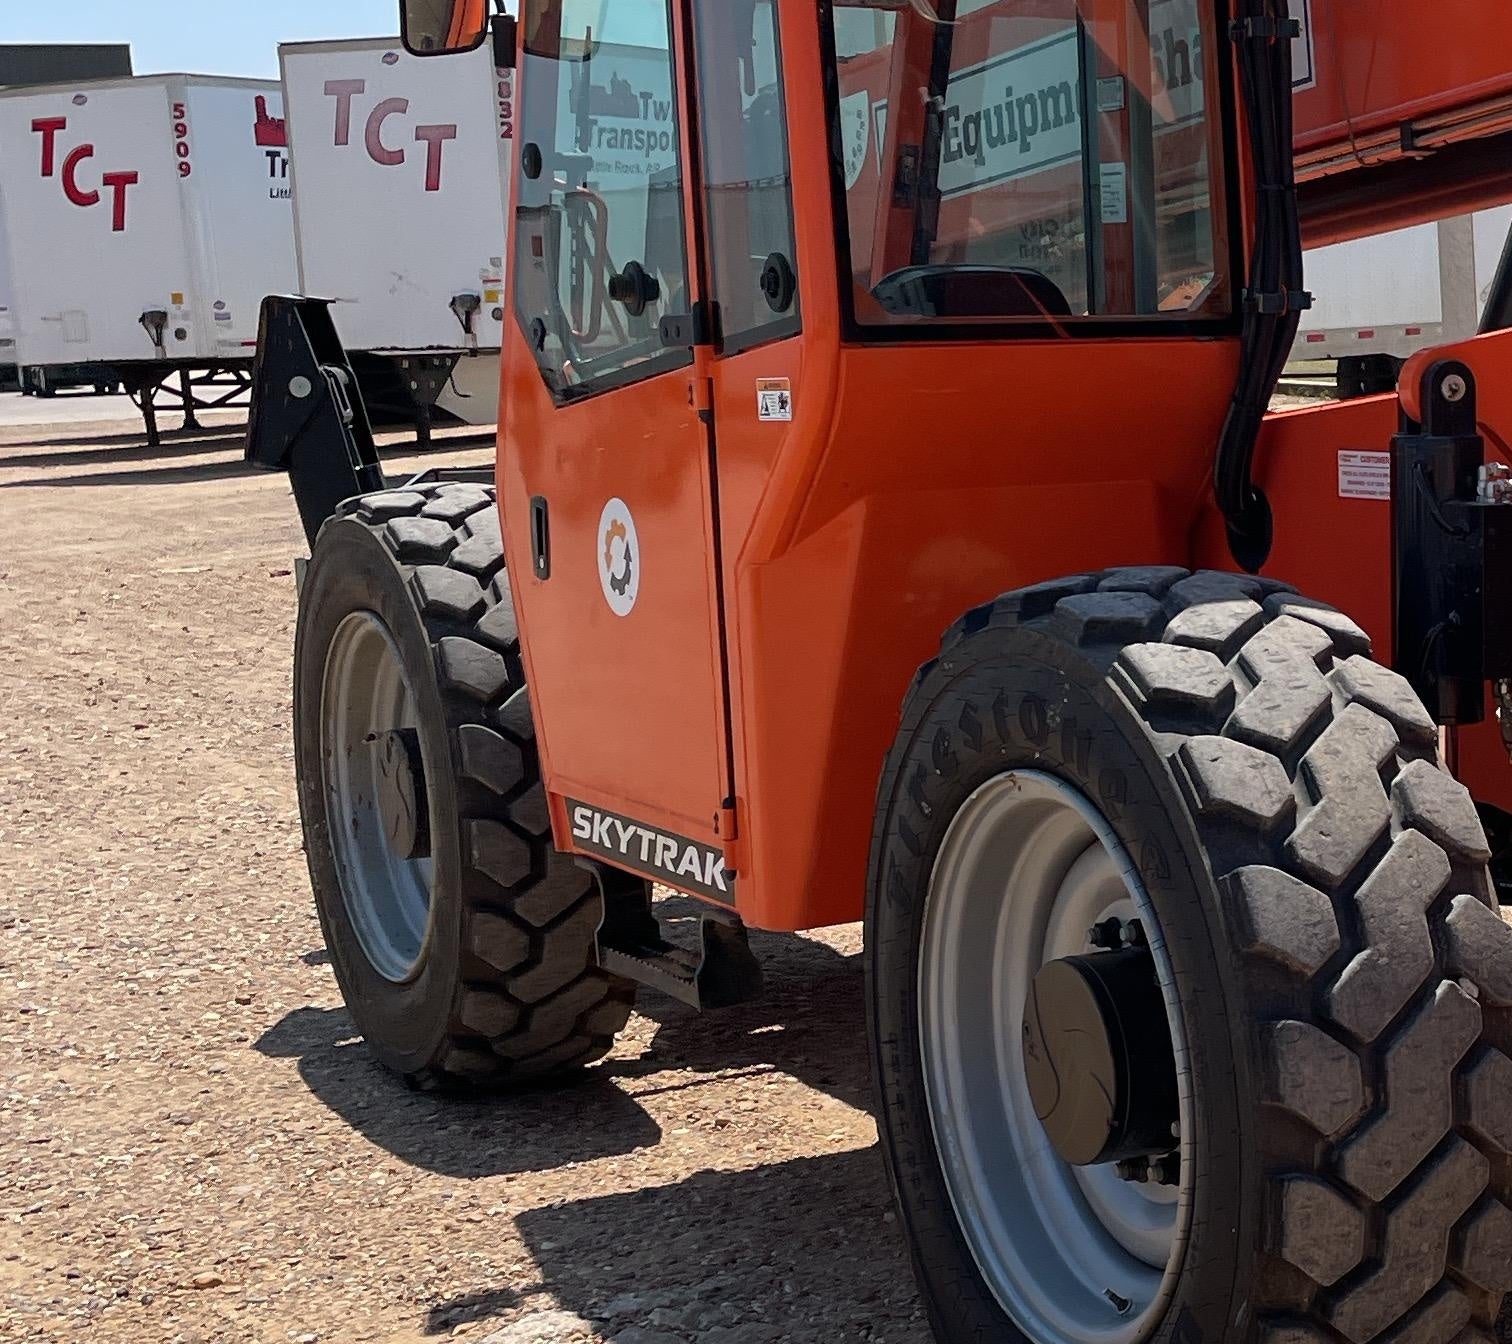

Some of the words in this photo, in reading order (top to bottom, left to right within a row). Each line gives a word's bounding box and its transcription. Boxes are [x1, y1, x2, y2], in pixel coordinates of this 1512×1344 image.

[172, 102, 191, 178] 5909
[324, 78, 457, 192] TCT
[942, 80, 1081, 168] Equipm
[31, 115, 138, 231] TCT
[572, 805, 728, 892] SKYTRAK
